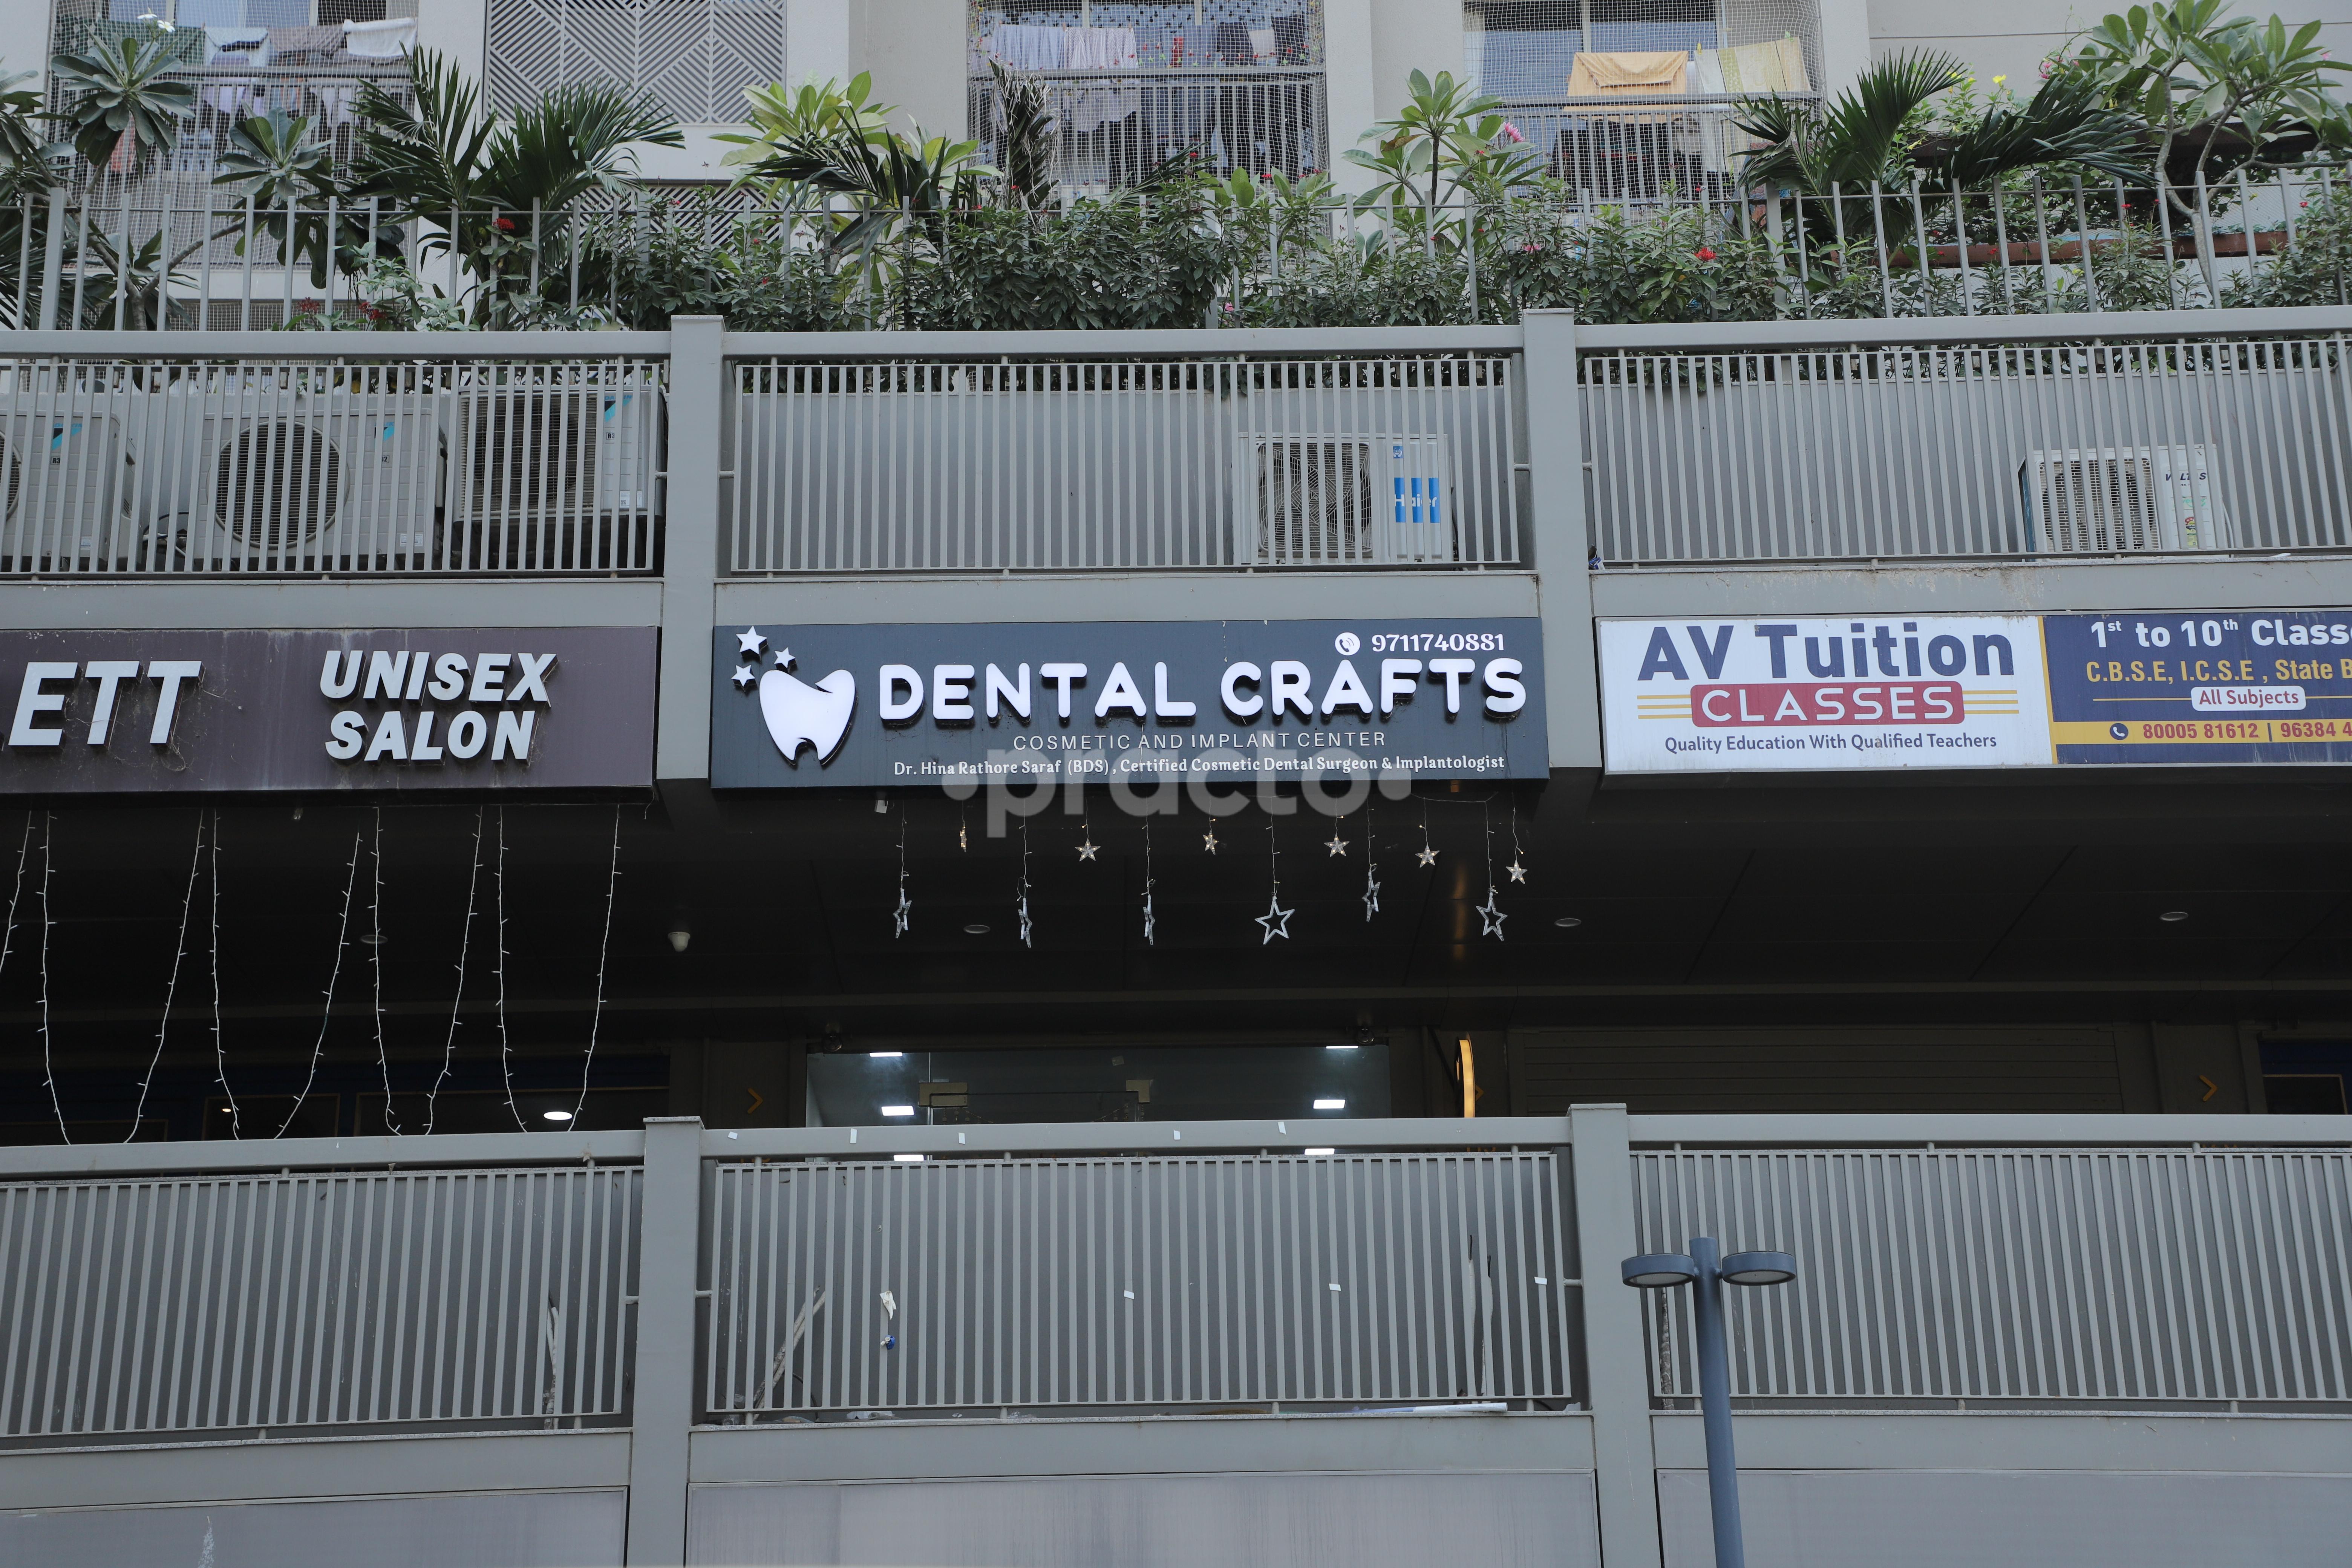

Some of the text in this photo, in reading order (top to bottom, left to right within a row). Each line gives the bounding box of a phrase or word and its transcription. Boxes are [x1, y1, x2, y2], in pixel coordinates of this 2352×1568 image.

[1372, 634, 1504, 652] 9711740881
[2135, 622, 2170, 647] to
[2251, 619, 2352, 646] Class
[1637, 622, 2014, 681] AV Tuition
[320, 650, 557, 702] UNISEX
[2275, 659, 2333, 680] State
[879, 658, 1526, 719] DENTAL CRAFTS
[2200, 690, 2298, 708] All Subjects
[1701, 686, 1954, 722] CLASSES
[325, 710, 535, 761] SALON
[1014, 732, 1384, 750] COSMETIC AND IMPLANT CENTER
[2143, 723, 2197, 739] 80005
[2203, 723, 2260, 739] 81612
[2280, 722, 2337, 738] 96384
[1665, 732, 1997, 755] Quality Education With Qualified Teachers
[894, 762, 917, 775] Dr.
[921, 762, 955, 775] Hina
[959, 761, 1018, 774] Rathore
[1022, 760, 1061, 773] Saraf
[1120, 758, 1187, 772] Certified
[1191, 758, 1260, 771] Cosmetic
[1264, 757, 1314, 770] Dental
[1317, 757, 1378, 773] Surgeon
[1382, 757, 1392, 769] &
[1396, 755, 1505, 772] Implantologist
